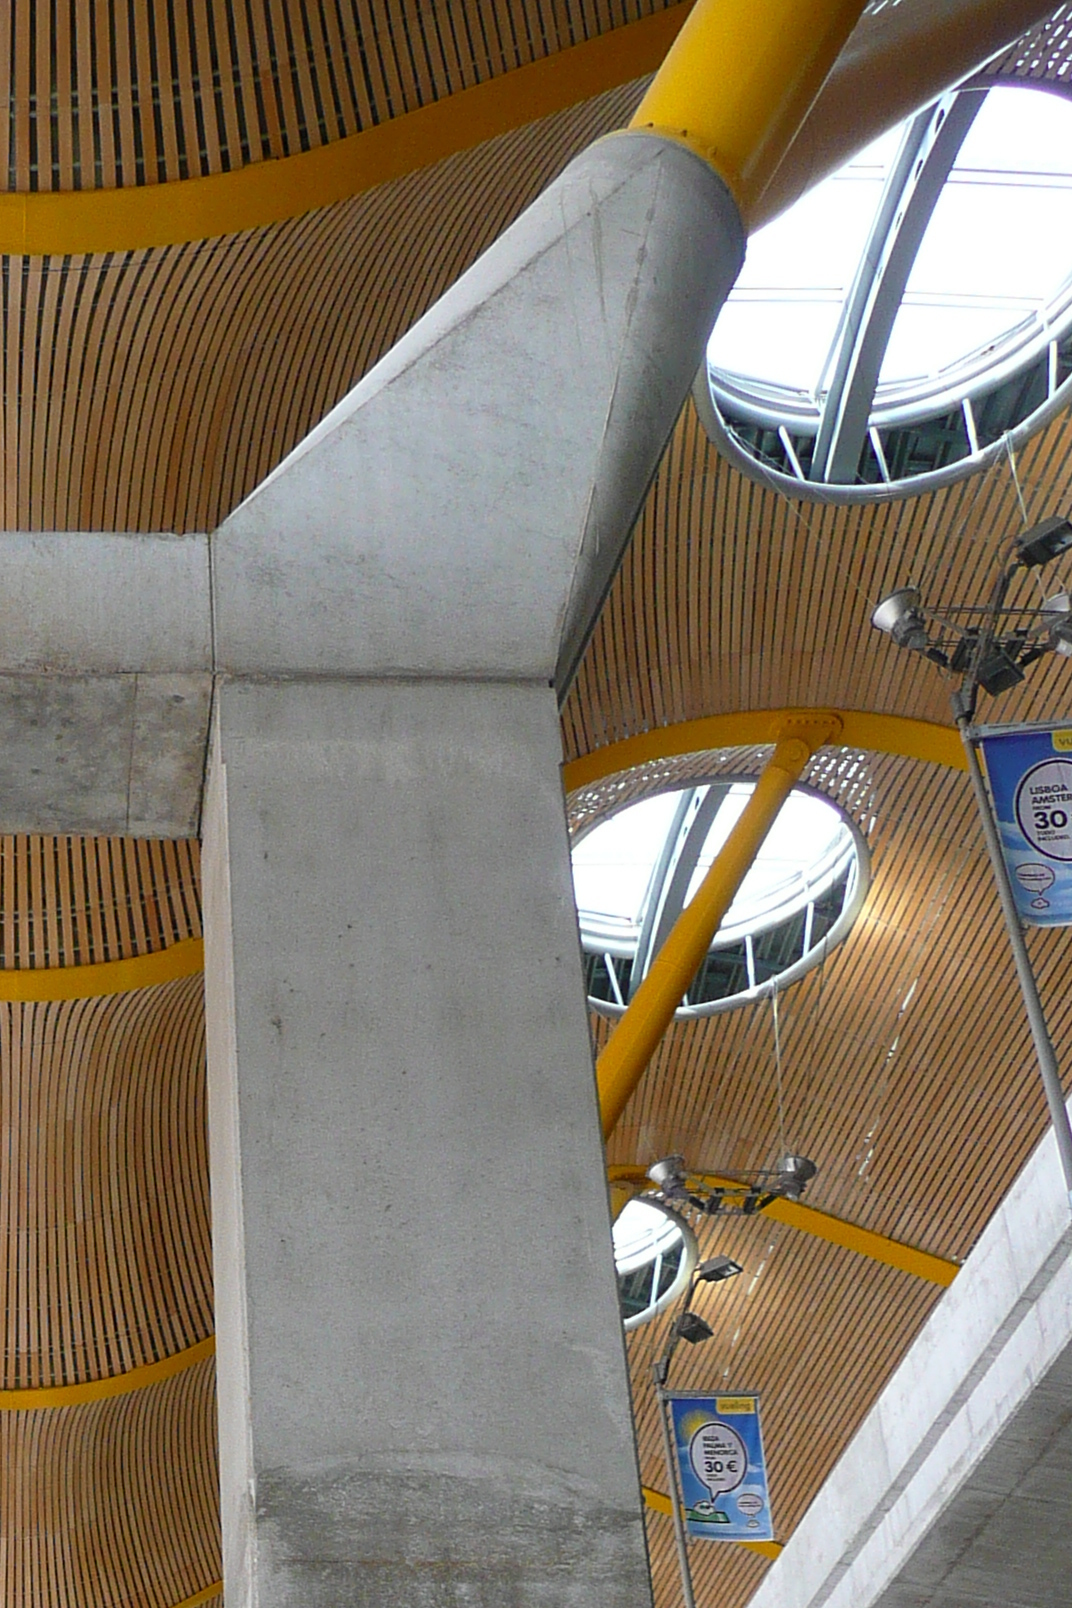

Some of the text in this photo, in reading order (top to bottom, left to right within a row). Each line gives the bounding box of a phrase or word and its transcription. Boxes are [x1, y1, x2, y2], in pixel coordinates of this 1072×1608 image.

[1029, 784, 1068, 794] LISBOA
[1034, 809, 1068, 829] 30
[704, 1460, 738, 1473] 30 €
